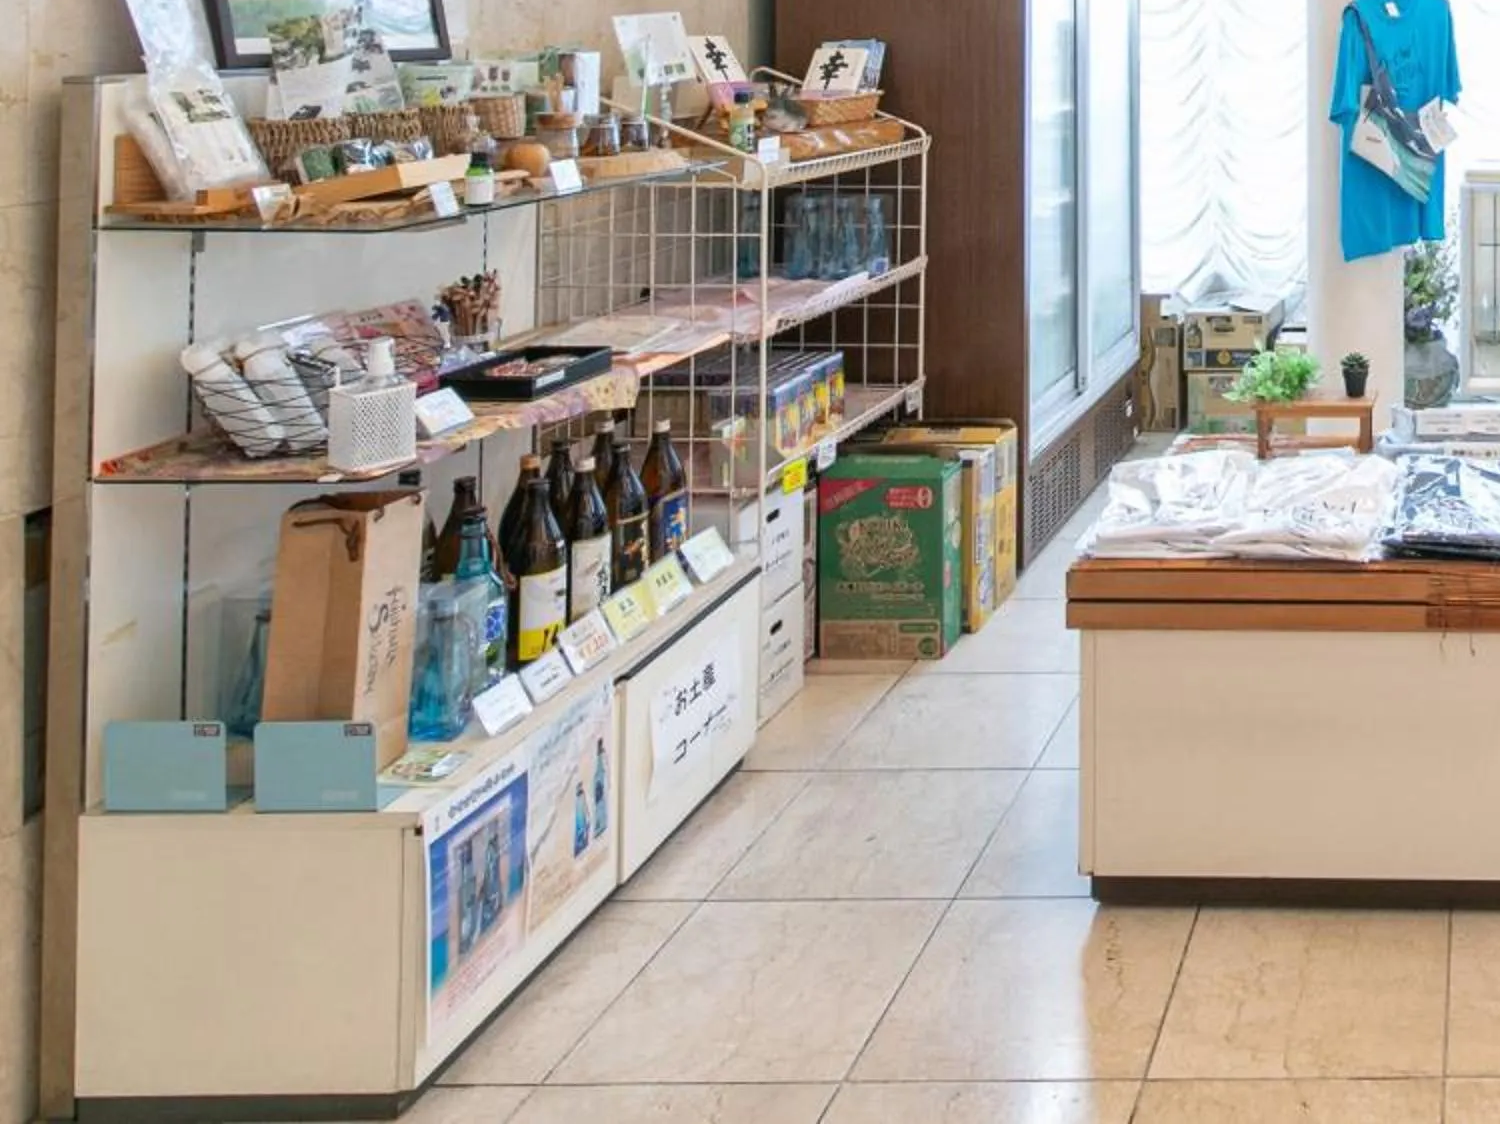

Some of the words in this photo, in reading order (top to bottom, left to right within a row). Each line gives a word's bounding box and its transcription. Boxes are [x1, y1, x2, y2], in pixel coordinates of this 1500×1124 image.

[674, 661, 717, 717] お土産
[673, 703, 727, 765] コーナー
